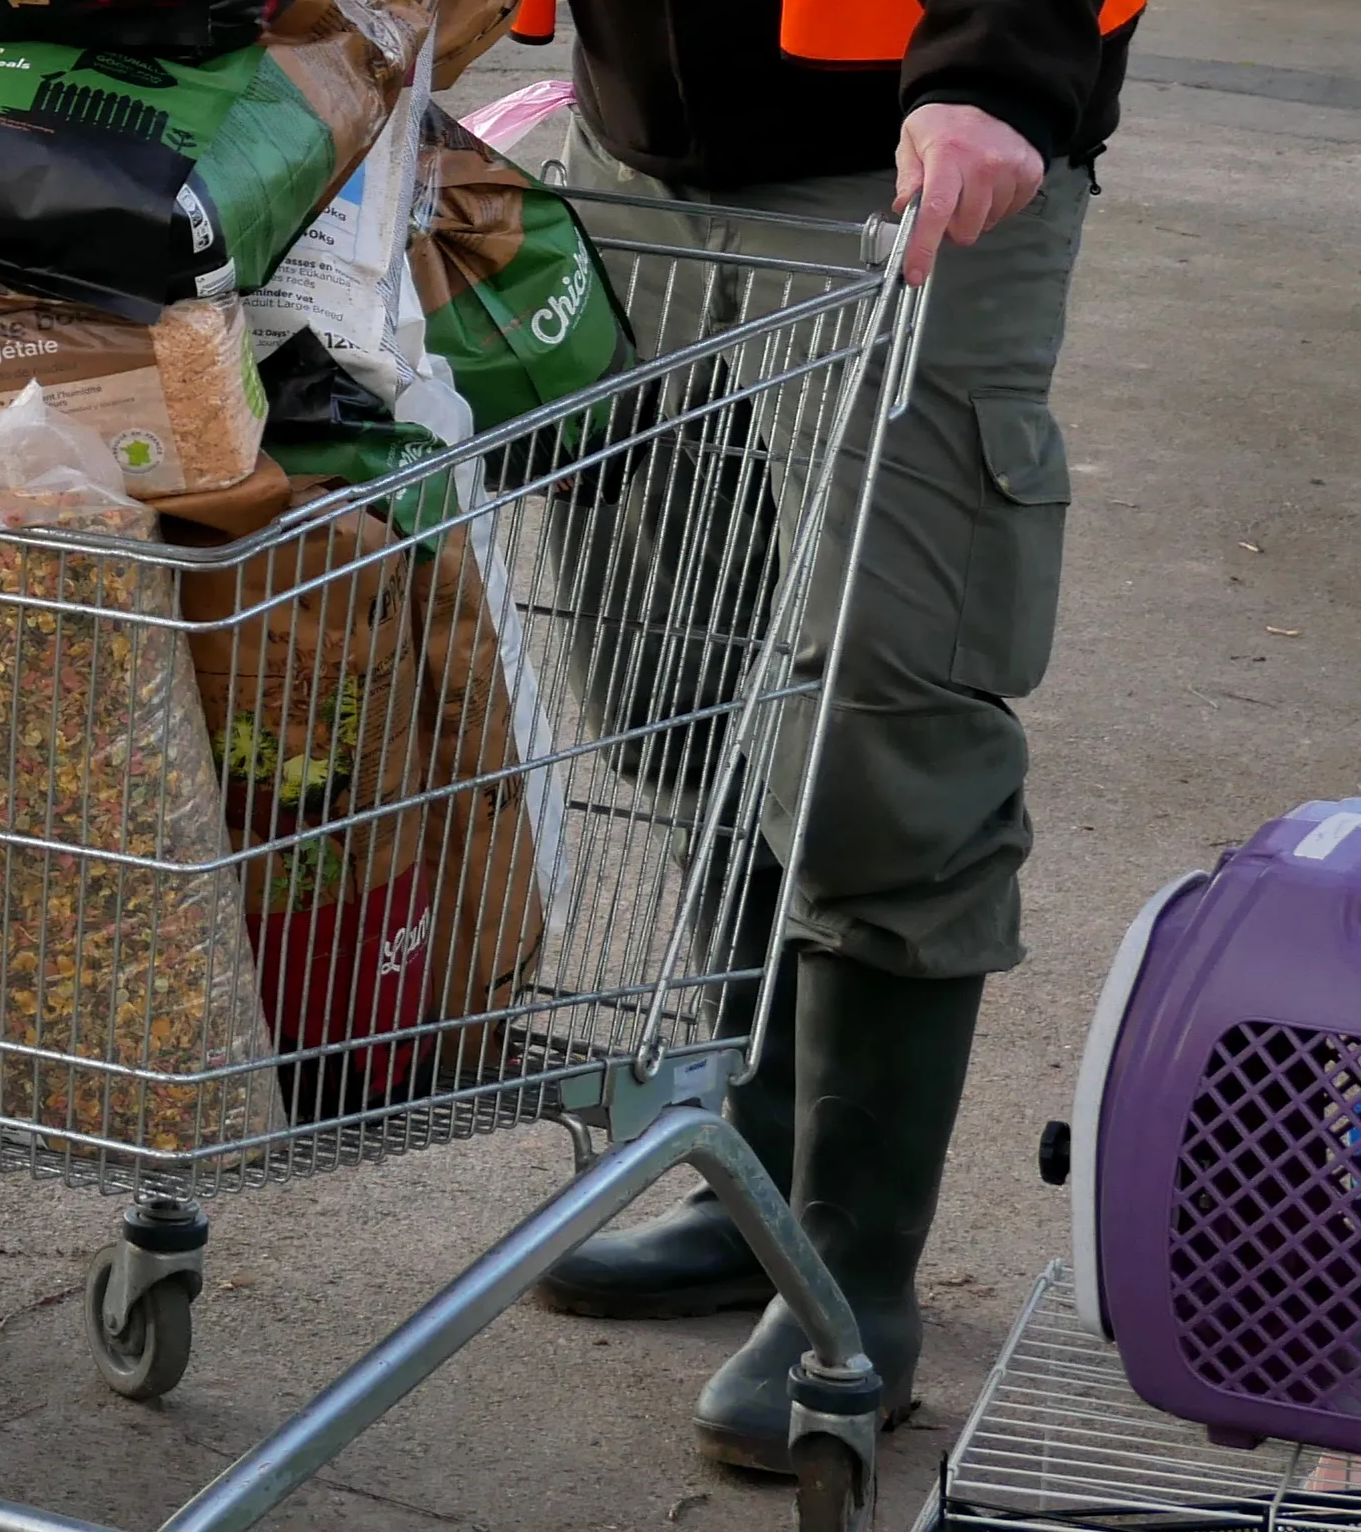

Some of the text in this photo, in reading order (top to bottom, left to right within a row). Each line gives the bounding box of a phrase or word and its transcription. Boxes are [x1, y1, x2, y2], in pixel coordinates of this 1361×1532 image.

[278, 264, 296, 274] nts
[285, 257, 316, 269] asses
[271, 274, 284, 282] es
[531, 225, 589, 344] Chic
[251, 287, 294, 299] minder
[242, 297, 344, 322] Adult Large Breed
